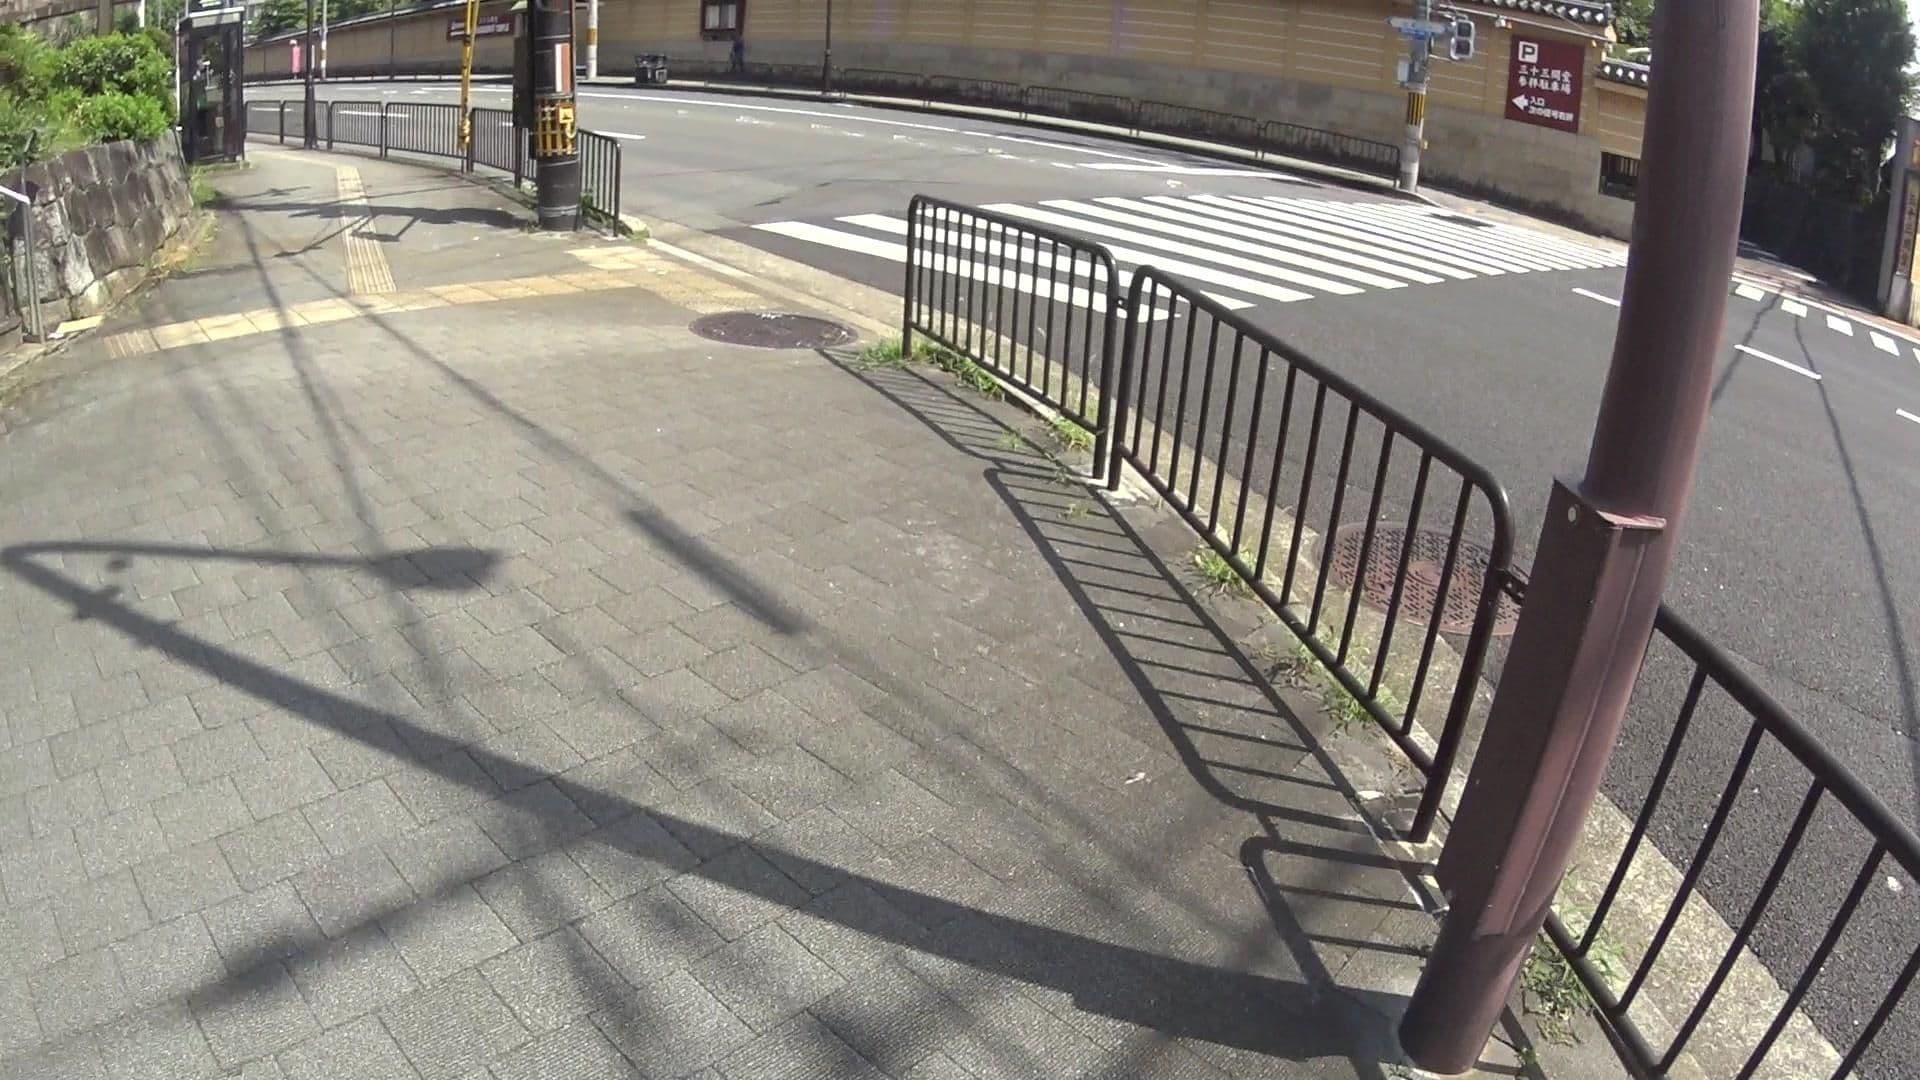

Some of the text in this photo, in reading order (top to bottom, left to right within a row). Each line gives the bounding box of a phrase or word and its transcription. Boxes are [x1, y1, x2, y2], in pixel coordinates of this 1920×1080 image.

[1518, 65, 1572, 84] 三十三間堂
[1530, 96, 1545, 106] 入口
